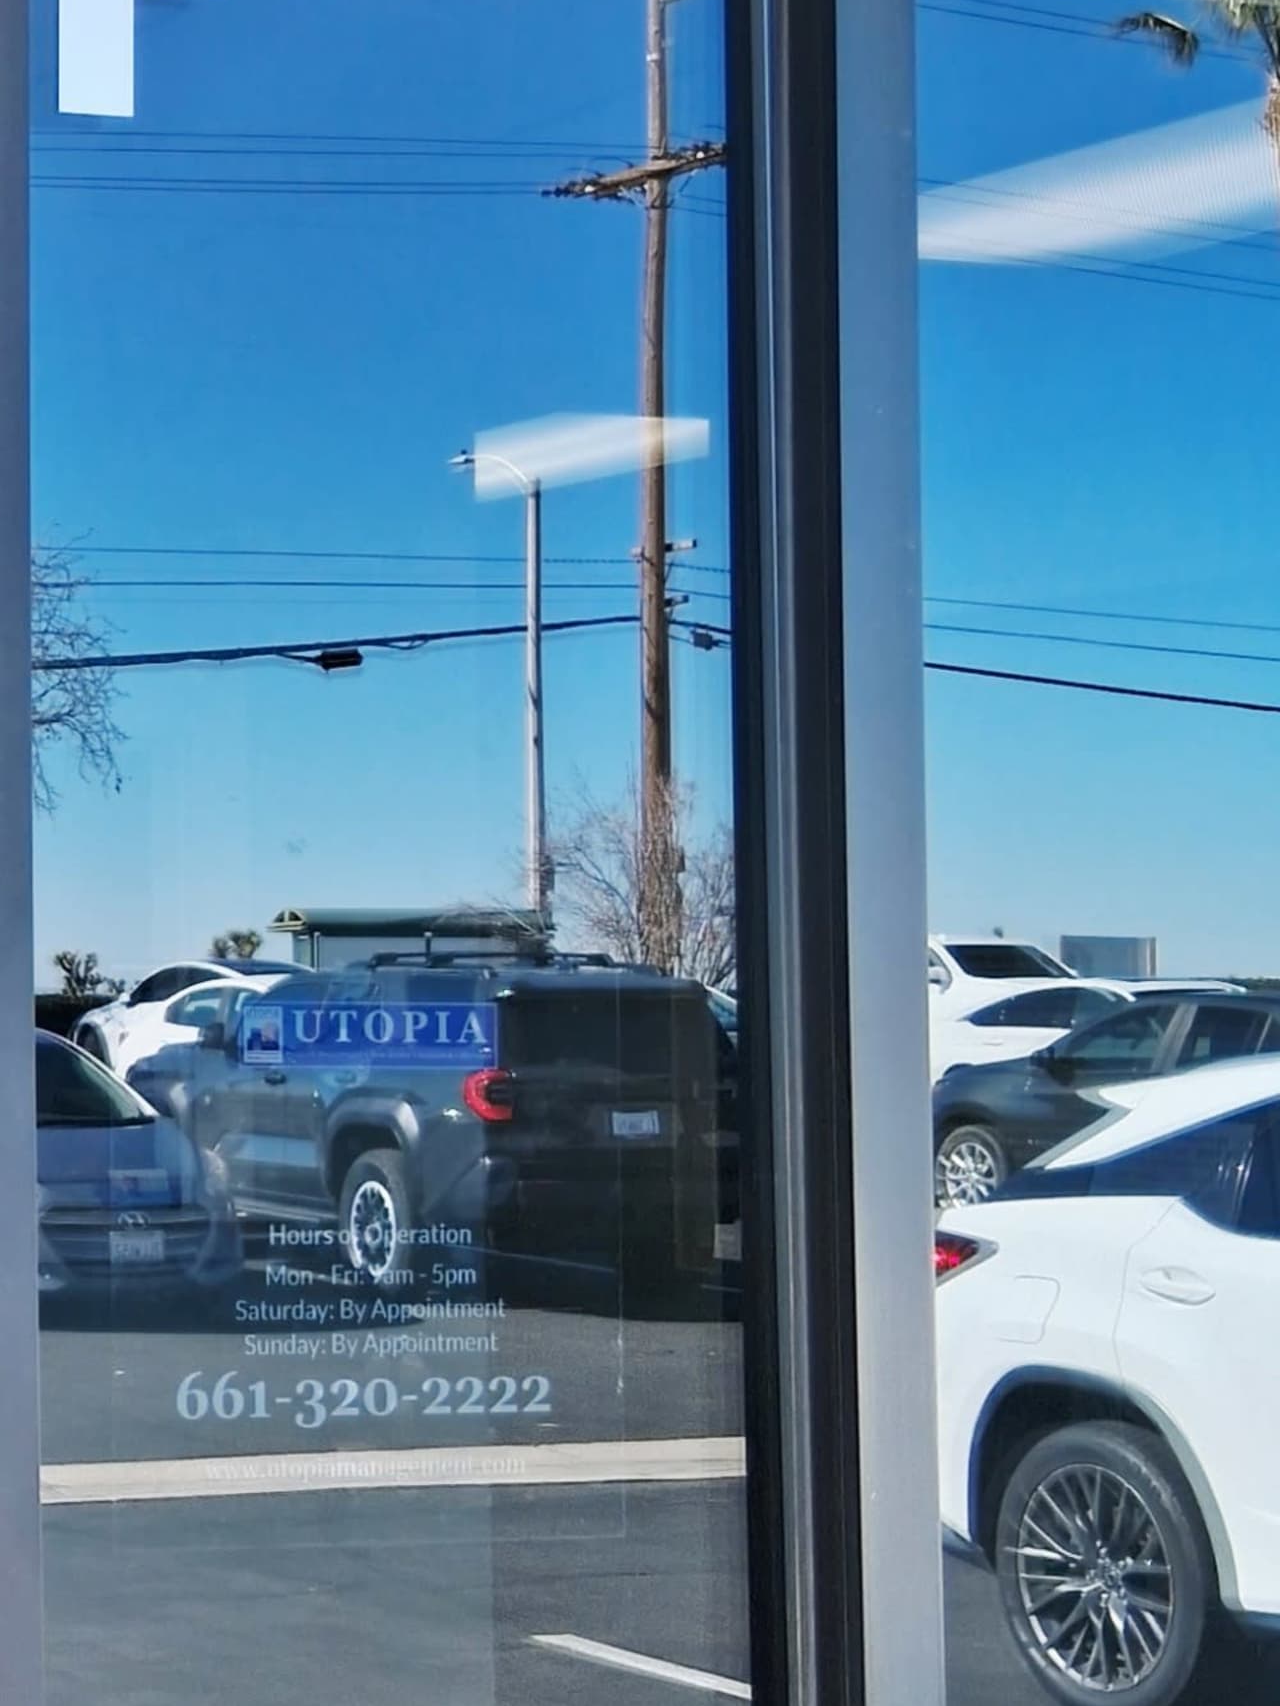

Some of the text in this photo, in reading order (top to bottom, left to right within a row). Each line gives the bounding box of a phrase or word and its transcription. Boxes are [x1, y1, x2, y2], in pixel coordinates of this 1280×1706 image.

[293, 1009, 488, 1044] UTOPIA
[269, 1224, 333, 1246] Hours
[338, 1223, 358, 1246] o
[265, 1264, 313, 1286] Mon
[331, 1263, 365, 1286] Fri:
[431, 1263, 477, 1288] 5pm
[235, 1297, 507, 1324] Saturday: By Appointment
[244, 1331, 500, 1358] Sunday: By Appointment
[175, 1370, 553, 1429] 661-320-2222
